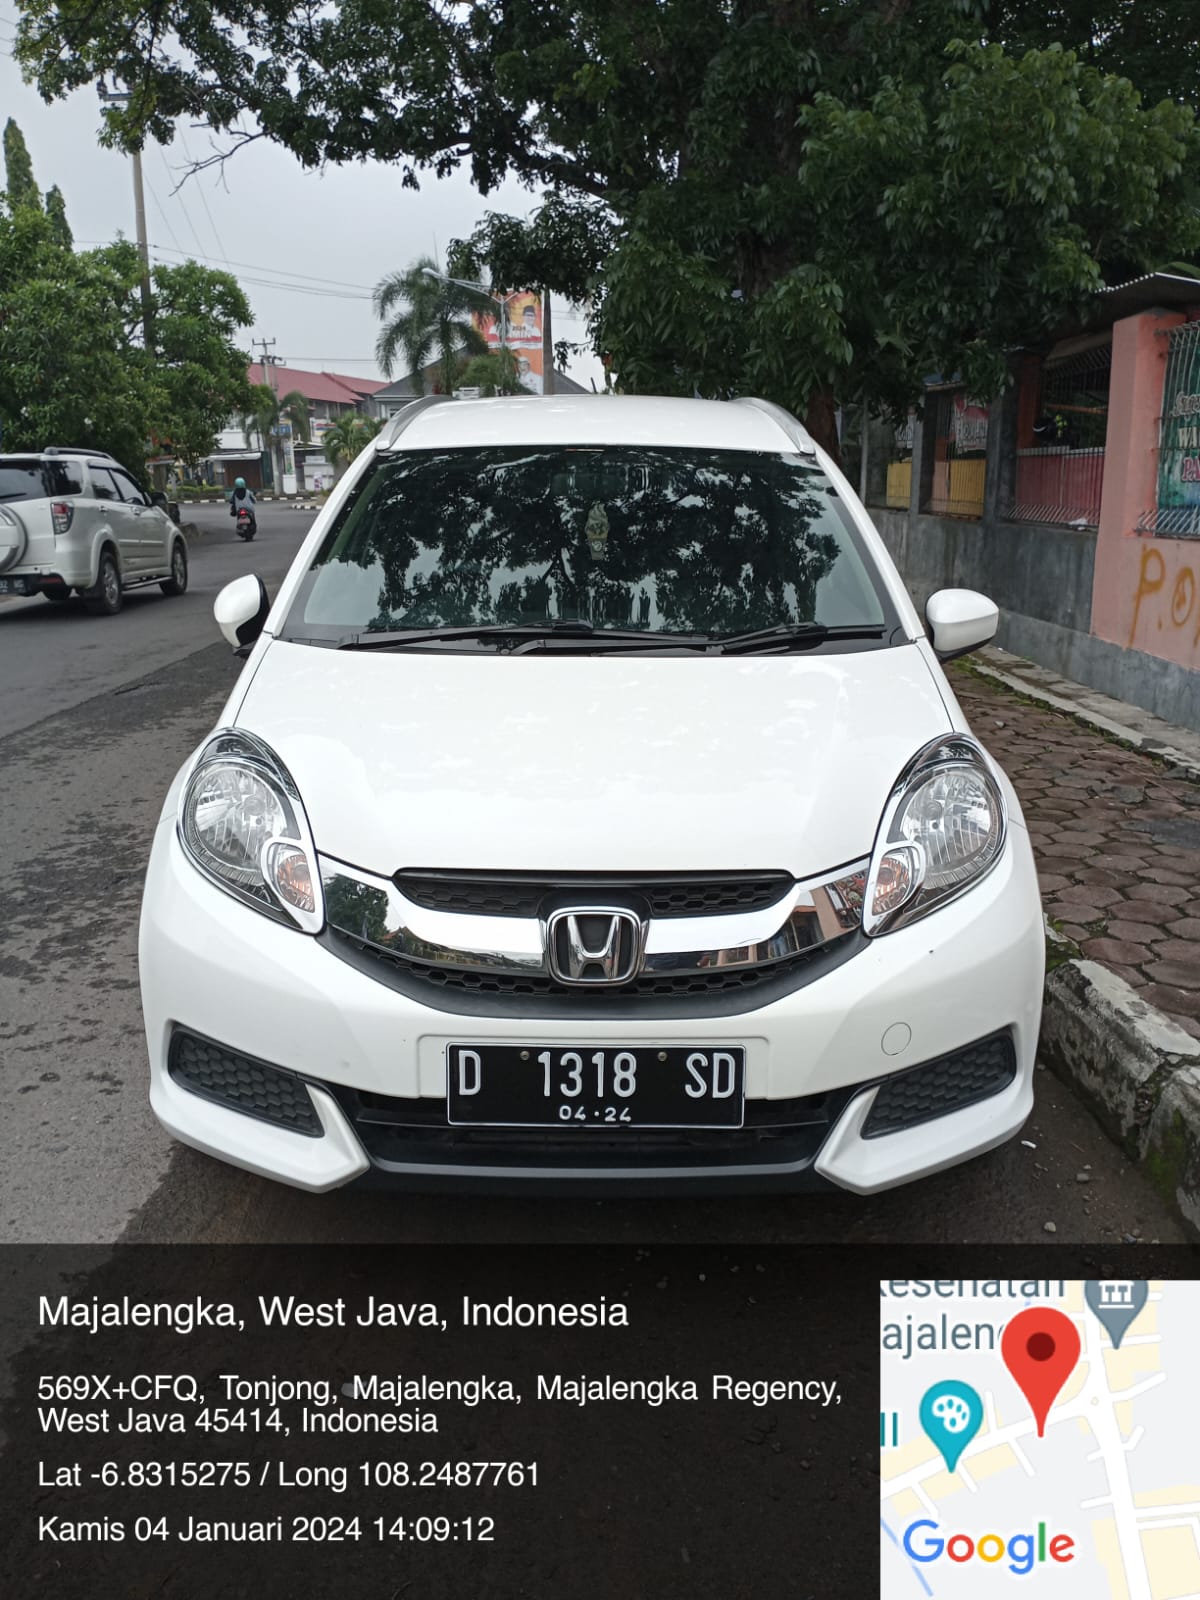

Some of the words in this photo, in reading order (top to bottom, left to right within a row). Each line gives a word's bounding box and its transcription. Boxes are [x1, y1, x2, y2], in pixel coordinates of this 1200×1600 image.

[1178, 426, 1200, 449] WA
[1128, 543, 1200, 648] P.O
[458, 1050, 481, 1096] D
[537, 1052, 637, 1098] 1318
[684, 1052, 736, 1099] SD
